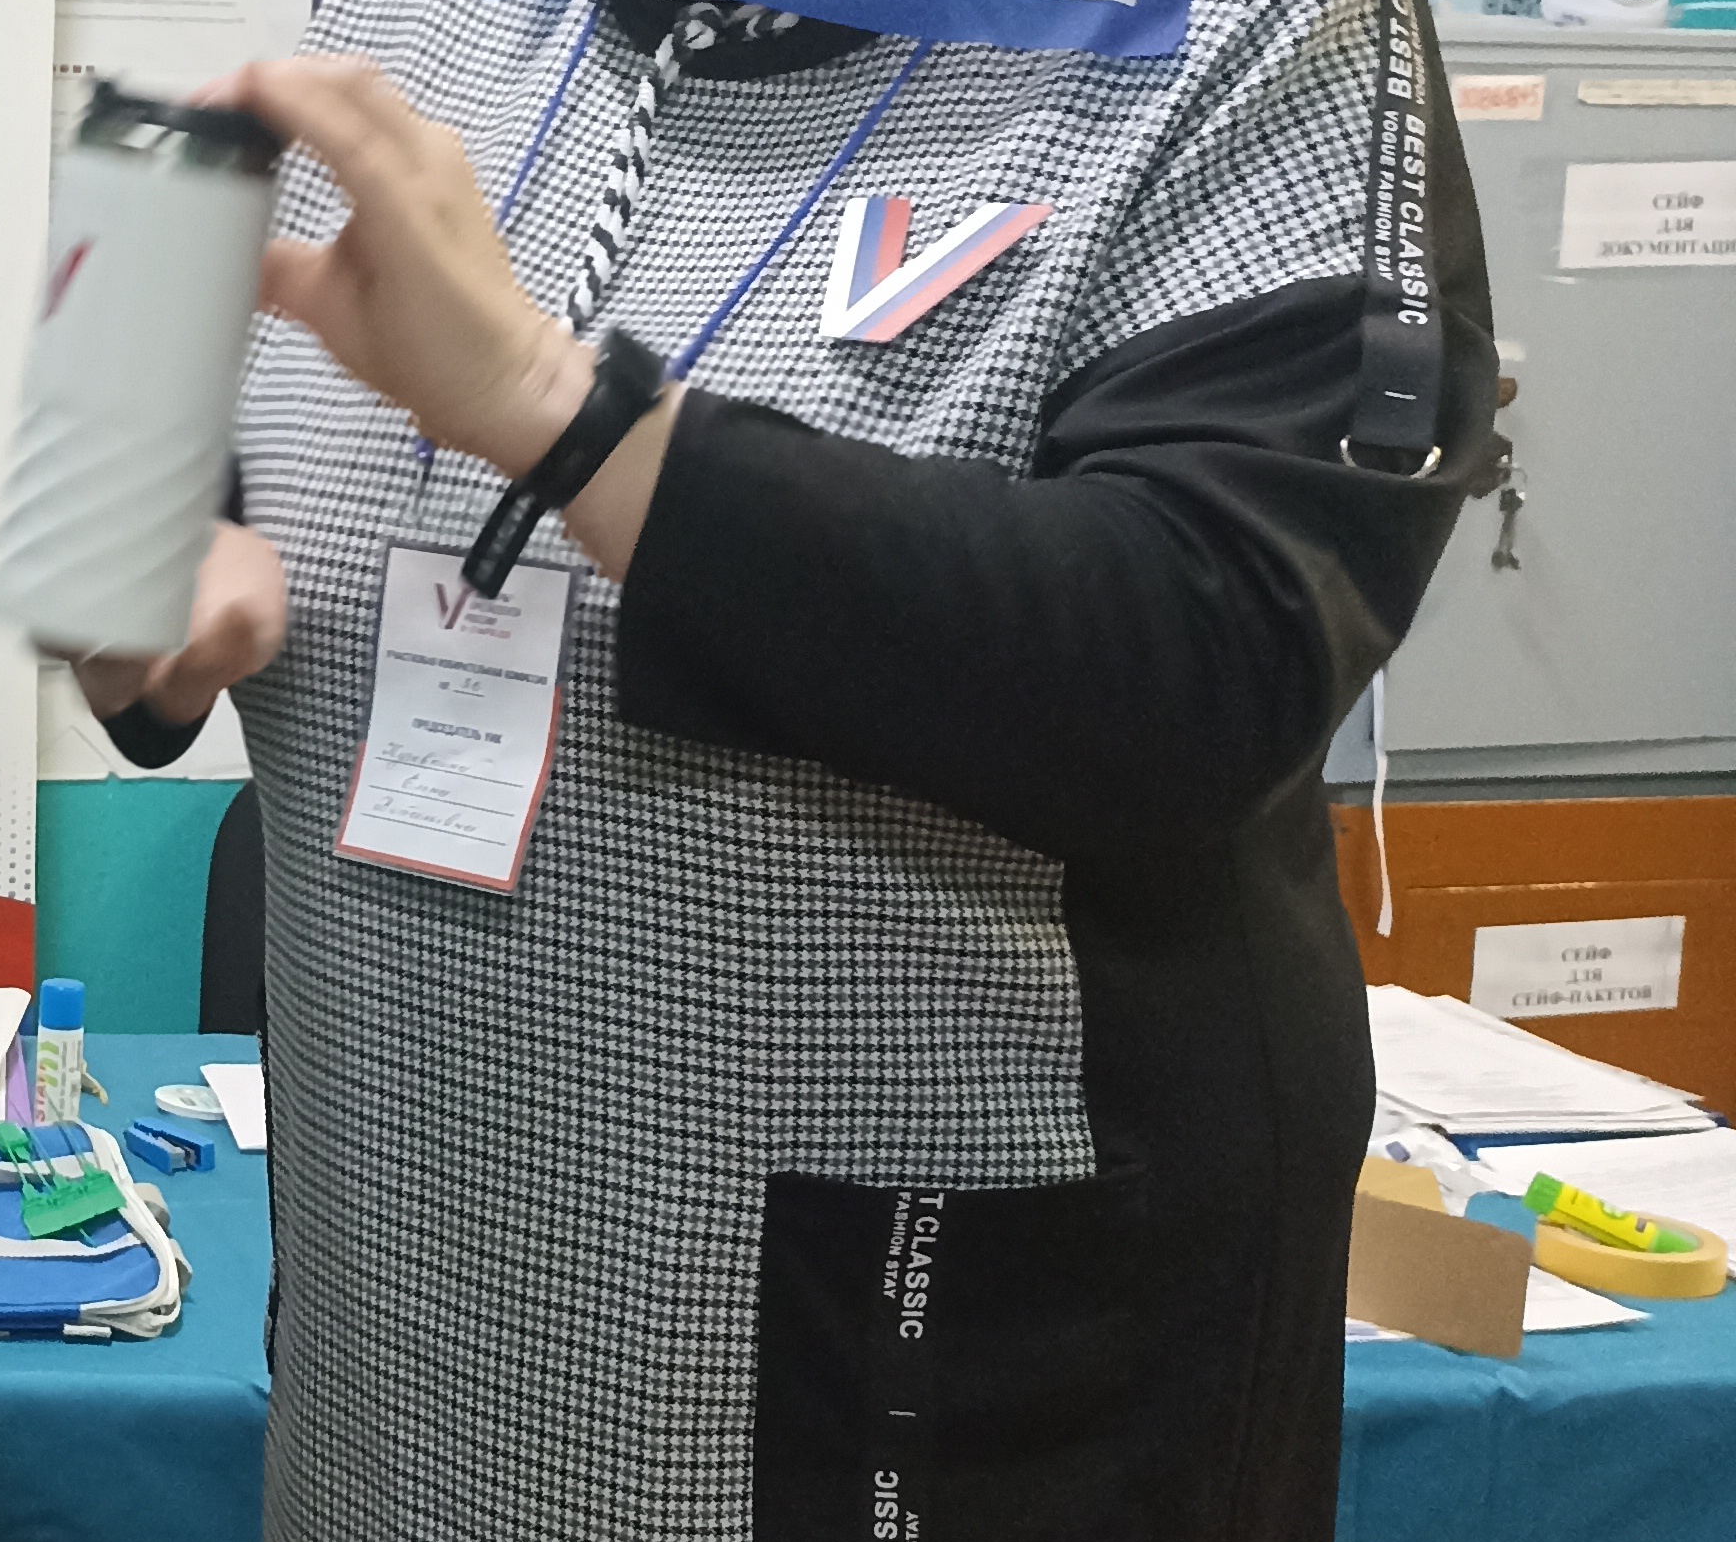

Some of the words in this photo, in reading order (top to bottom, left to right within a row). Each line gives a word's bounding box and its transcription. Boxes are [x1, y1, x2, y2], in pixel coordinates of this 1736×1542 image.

[1402, 113, 1427, 198] BEST
[1397, 201, 1429, 326] CLASSIC
[1599, 239, 1736, 256] ДОКУМЕНТАЦИ
[888, 1191, 913, 1256] FASHION
[898, 1215, 941, 1340] CLASSIC
